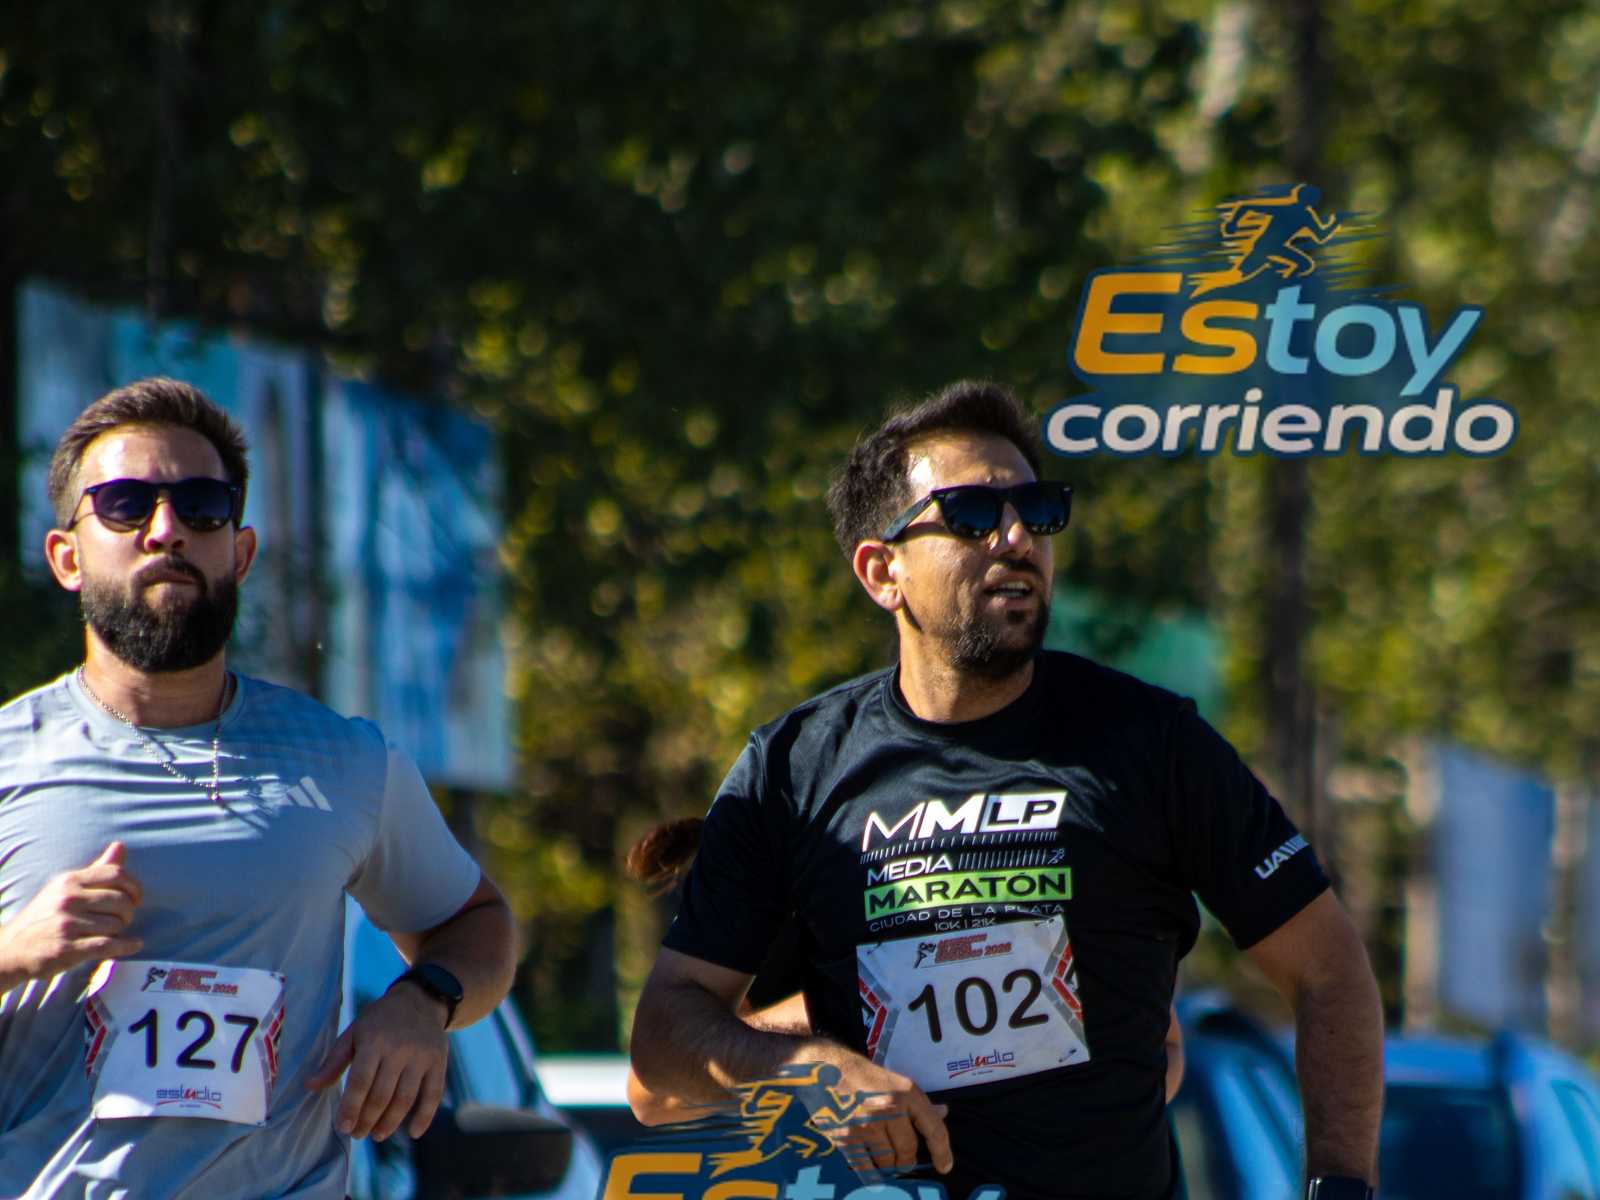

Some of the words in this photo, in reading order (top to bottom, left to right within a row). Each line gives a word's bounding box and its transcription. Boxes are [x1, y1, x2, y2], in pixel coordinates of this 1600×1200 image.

[867, 853, 953, 886] MEDIA
[869, 872, 1067, 915] MARATÓN
[869, 911, 930, 933] CIUDAD
[938, 908, 962, 919] DE
[971, 905, 996, 916] LA
[1004, 903, 1065, 914] PLATA
[908, 968, 1050, 1044] 102
[128, 1008, 259, 1073] 127
[946, 1049, 1015, 1072] estudio
[156, 1084, 222, 1101] estudio
